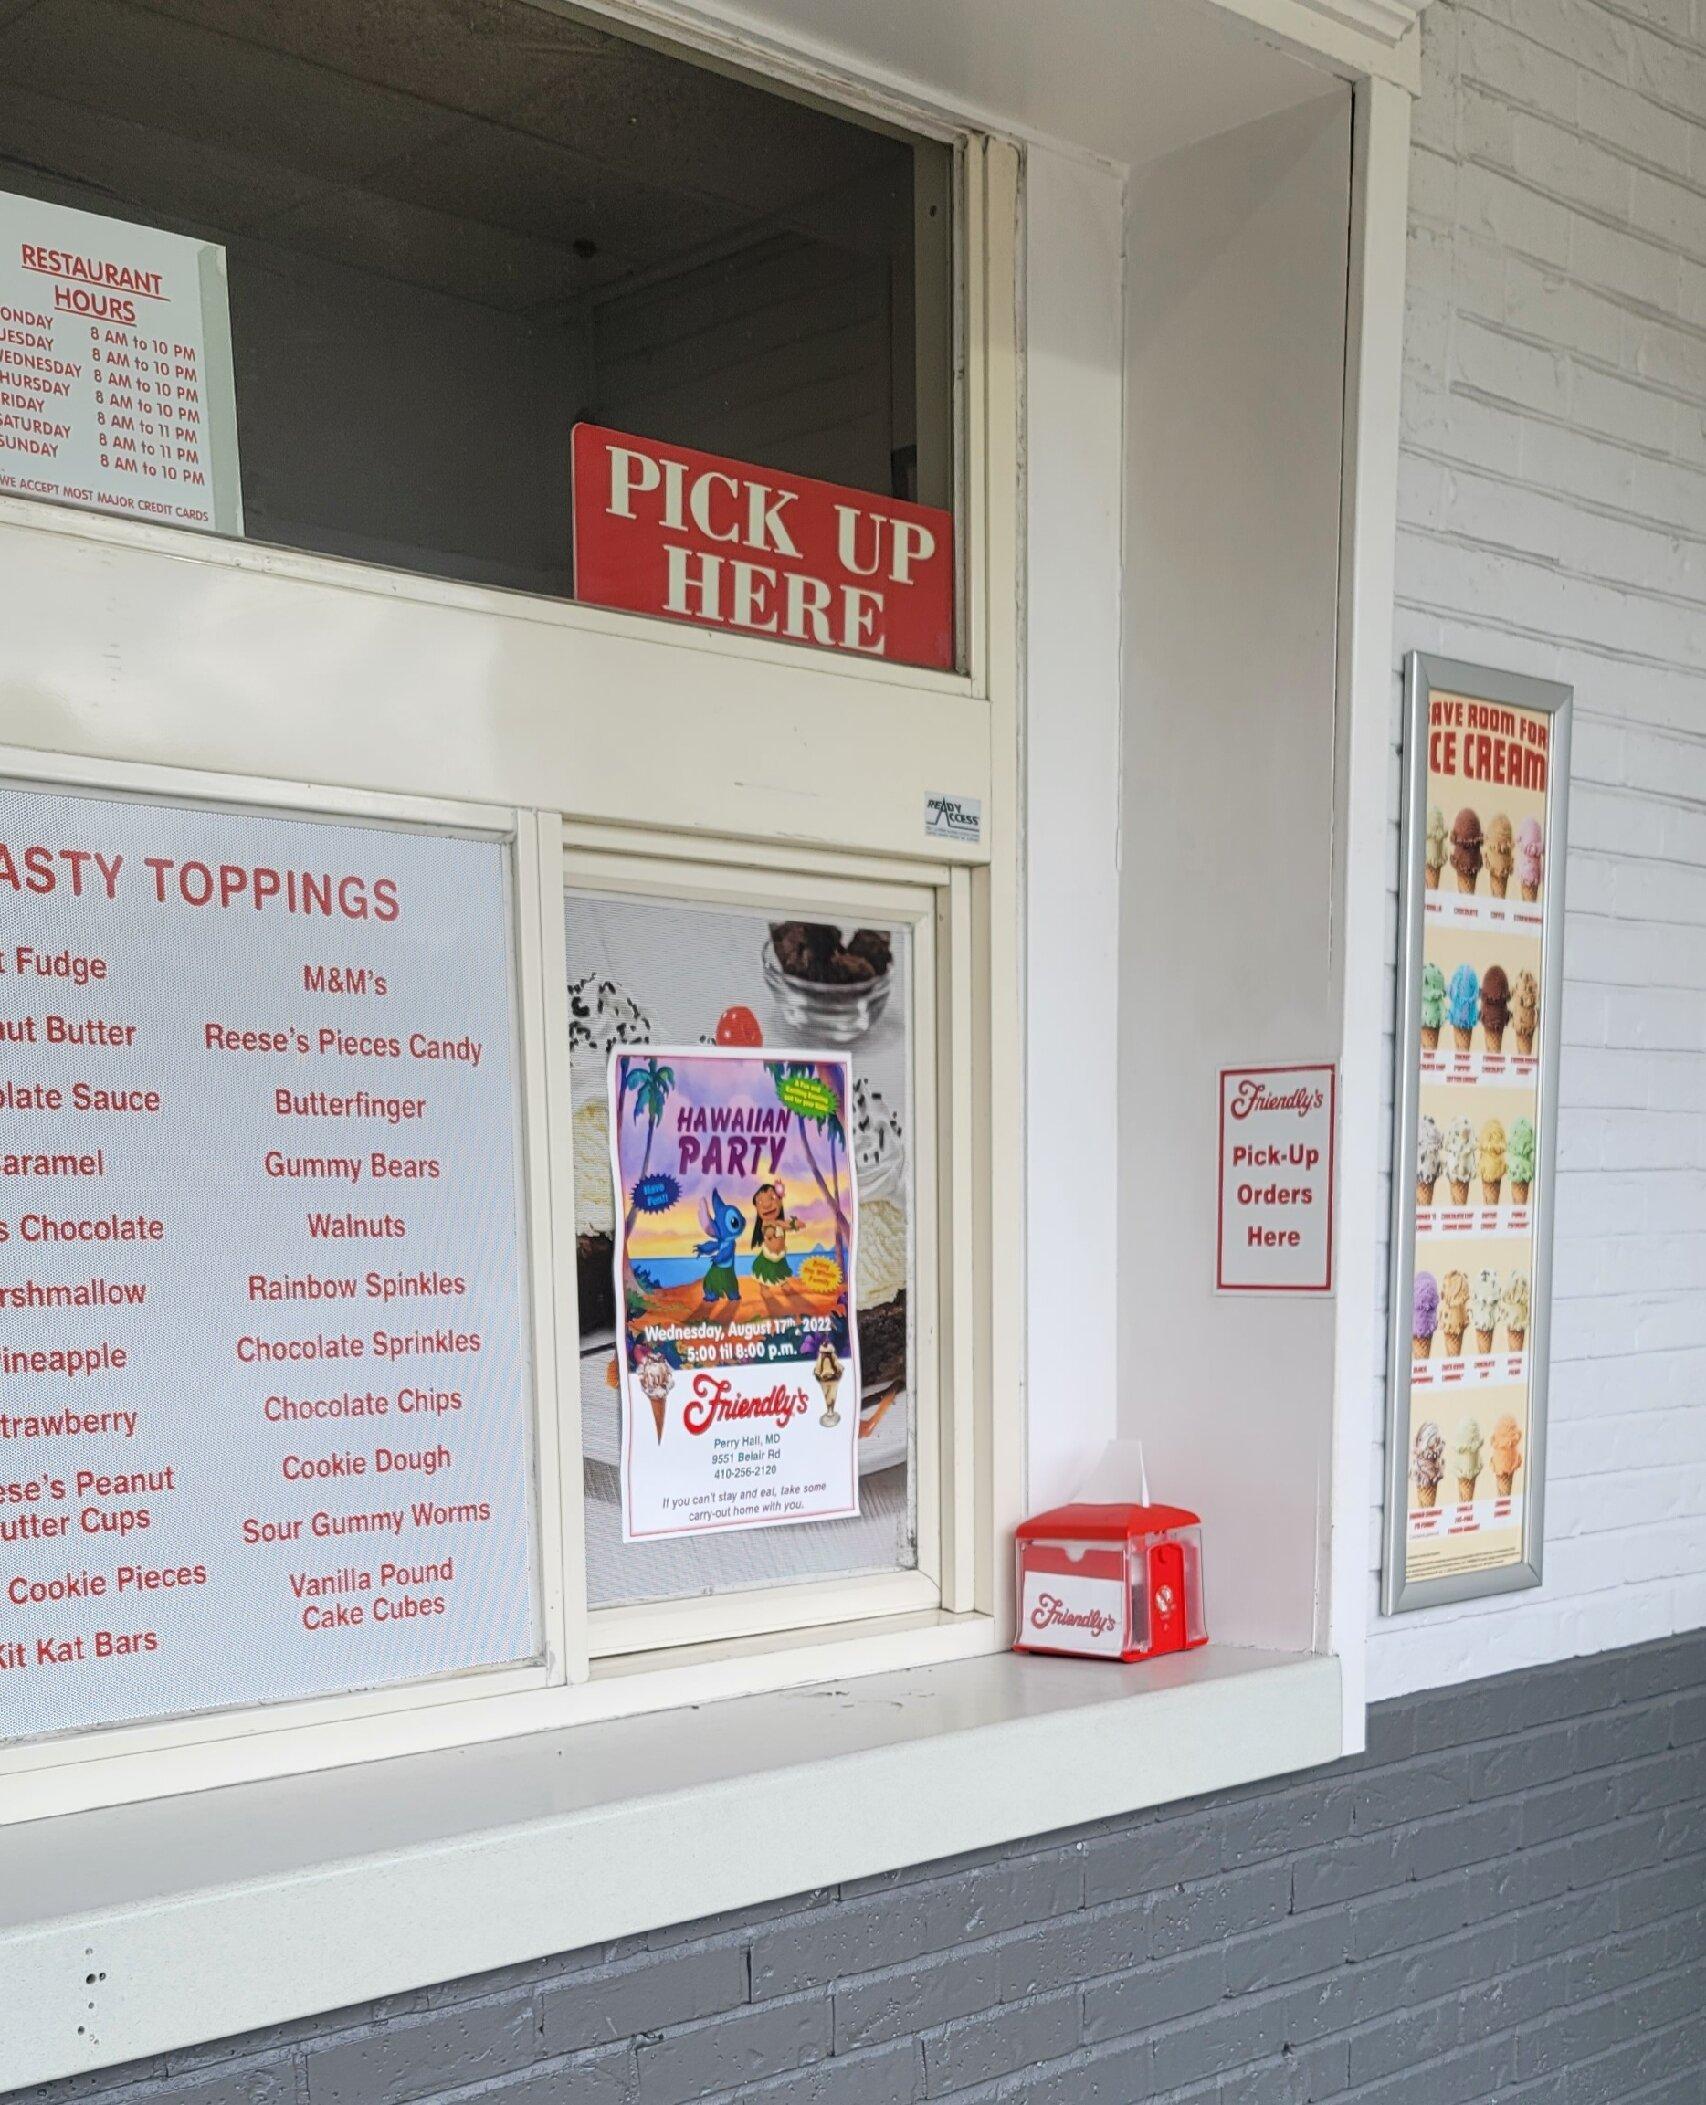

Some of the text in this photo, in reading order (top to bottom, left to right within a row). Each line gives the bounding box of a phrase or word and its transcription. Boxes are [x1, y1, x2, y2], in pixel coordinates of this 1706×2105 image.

[21, 243, 163, 296] RESTAURANT
[54, 284, 136, 323] HOURS
[90, 326, 197, 362] 8 AM to 10 PM
[92, 348, 198, 383] 8 AM to 10 PM
[94, 369, 199, 404] 8 AM to 10 PM
[95, 390, 200, 424] 8 AM to 10 PM
[97, 411, 198, 444] 8 AM to 11 PM
[99, 433, 199, 464] 8 AM to 11 PM
[100, 454, 206, 486] 8 AM to 10 PM
[1, 475, 209, 522] WE ACCEPT MOST MAJOR CREDIT CARDS
[605, 445, 936, 585] PICK UP
[661, 543, 886, 656] HERE
[1468, 703, 1515, 739] ROOM
[1519, 717, 1548, 748] FOR
[1429, 731, 1547, 793] CE CREAM
[145, 857, 401, 922] TOPPINGS
[16, 947, 108, 985] Fudge
[304, 965, 388, 996] M&M's
[46, 1015, 137, 1047] Butter
[205, 1023, 482, 1067] Reese's Pieces Candy
[72, 1082, 160, 1112] Sauce
[275, 1088, 427, 1124] Butterfinger
[1231, 1080, 1323, 1120] Friendly's
[677, 1106, 792, 1134] HAWAIIAN
[264, 1151, 441, 1184] Gummy Bears
[678, 1135, 786, 1177] PARTY
[1232, 1143, 1319, 1170] Pick-Up
[1236, 1184, 1313, 1206] Orders
[20, 1213, 164, 1242] Chocolate
[307, 1212, 406, 1239] Walnuts
[1247, 1225, 1301, 1247] Here
[247, 1270, 466, 1303] Rainbow Spinkles
[236, 1328, 481, 1364] Chocolate Sprinkles
[645, 1324, 725, 1342] Wednesday,
[728, 1318, 772, 1340] August
[803, 1317, 832, 1333] 2022
[687, 1346, 717, 1363] 5:00
[719, 1342, 733, 1359] til
[768, 1342, 798, 1360] p.m.
[264, 1387, 463, 1422] Chocolate Chips
[683, 1373, 809, 1436] Friendly's
[713, 1438, 740, 1450] Perry
[765, 1433, 781, 1445] MD
[282, 1444, 452, 1480] Cookie Dough
[77, 1465, 175, 1497] Peanut
[672, 1497, 690, 1510] you
[718, 1490, 738, 1504] stay
[740, 1487, 758, 1501] and
[780, 1484, 801, 1498] take
[803, 1481, 827, 1494] some
[81, 1505, 151, 1537] Cups
[242, 1500, 491, 1544] Sour Gummy Worms
[688, 1508, 731, 1523] carry-out
[733, 1504, 760, 1518] home
[762, 1500, 782, 1514] with
[8, 1561, 207, 1606] Cookie Pieces
[289, 1557, 454, 1598] Vanilla Pound
[303, 1594, 446, 1631] Cake Cubes
[1030, 1592, 1116, 1638] Friendly's
[37, 1632, 85, 1665] Kat
[95, 1628, 158, 1658] Bars
